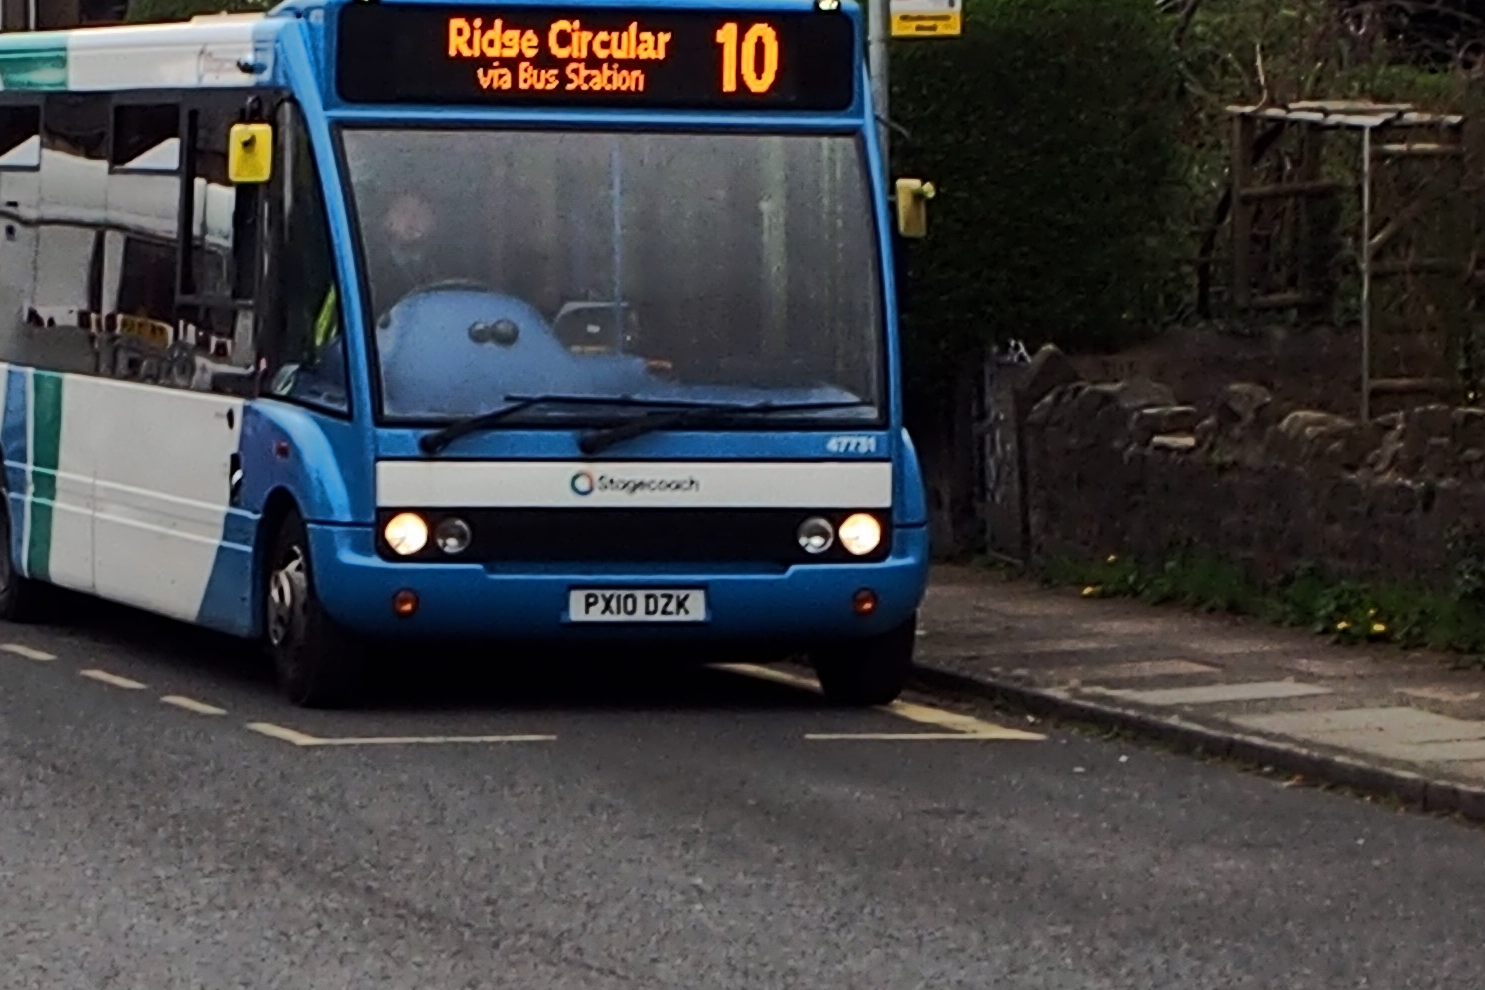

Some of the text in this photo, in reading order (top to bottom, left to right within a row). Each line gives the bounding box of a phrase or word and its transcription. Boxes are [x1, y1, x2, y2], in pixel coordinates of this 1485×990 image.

[447, 17, 672, 60] Ridge Circular
[715, 22, 779, 93] 10
[476, 61, 645, 93] via Bus Station
[597, 474, 701, 497] Stagecoach
[584, 592, 690, 616] PX10 DZK
